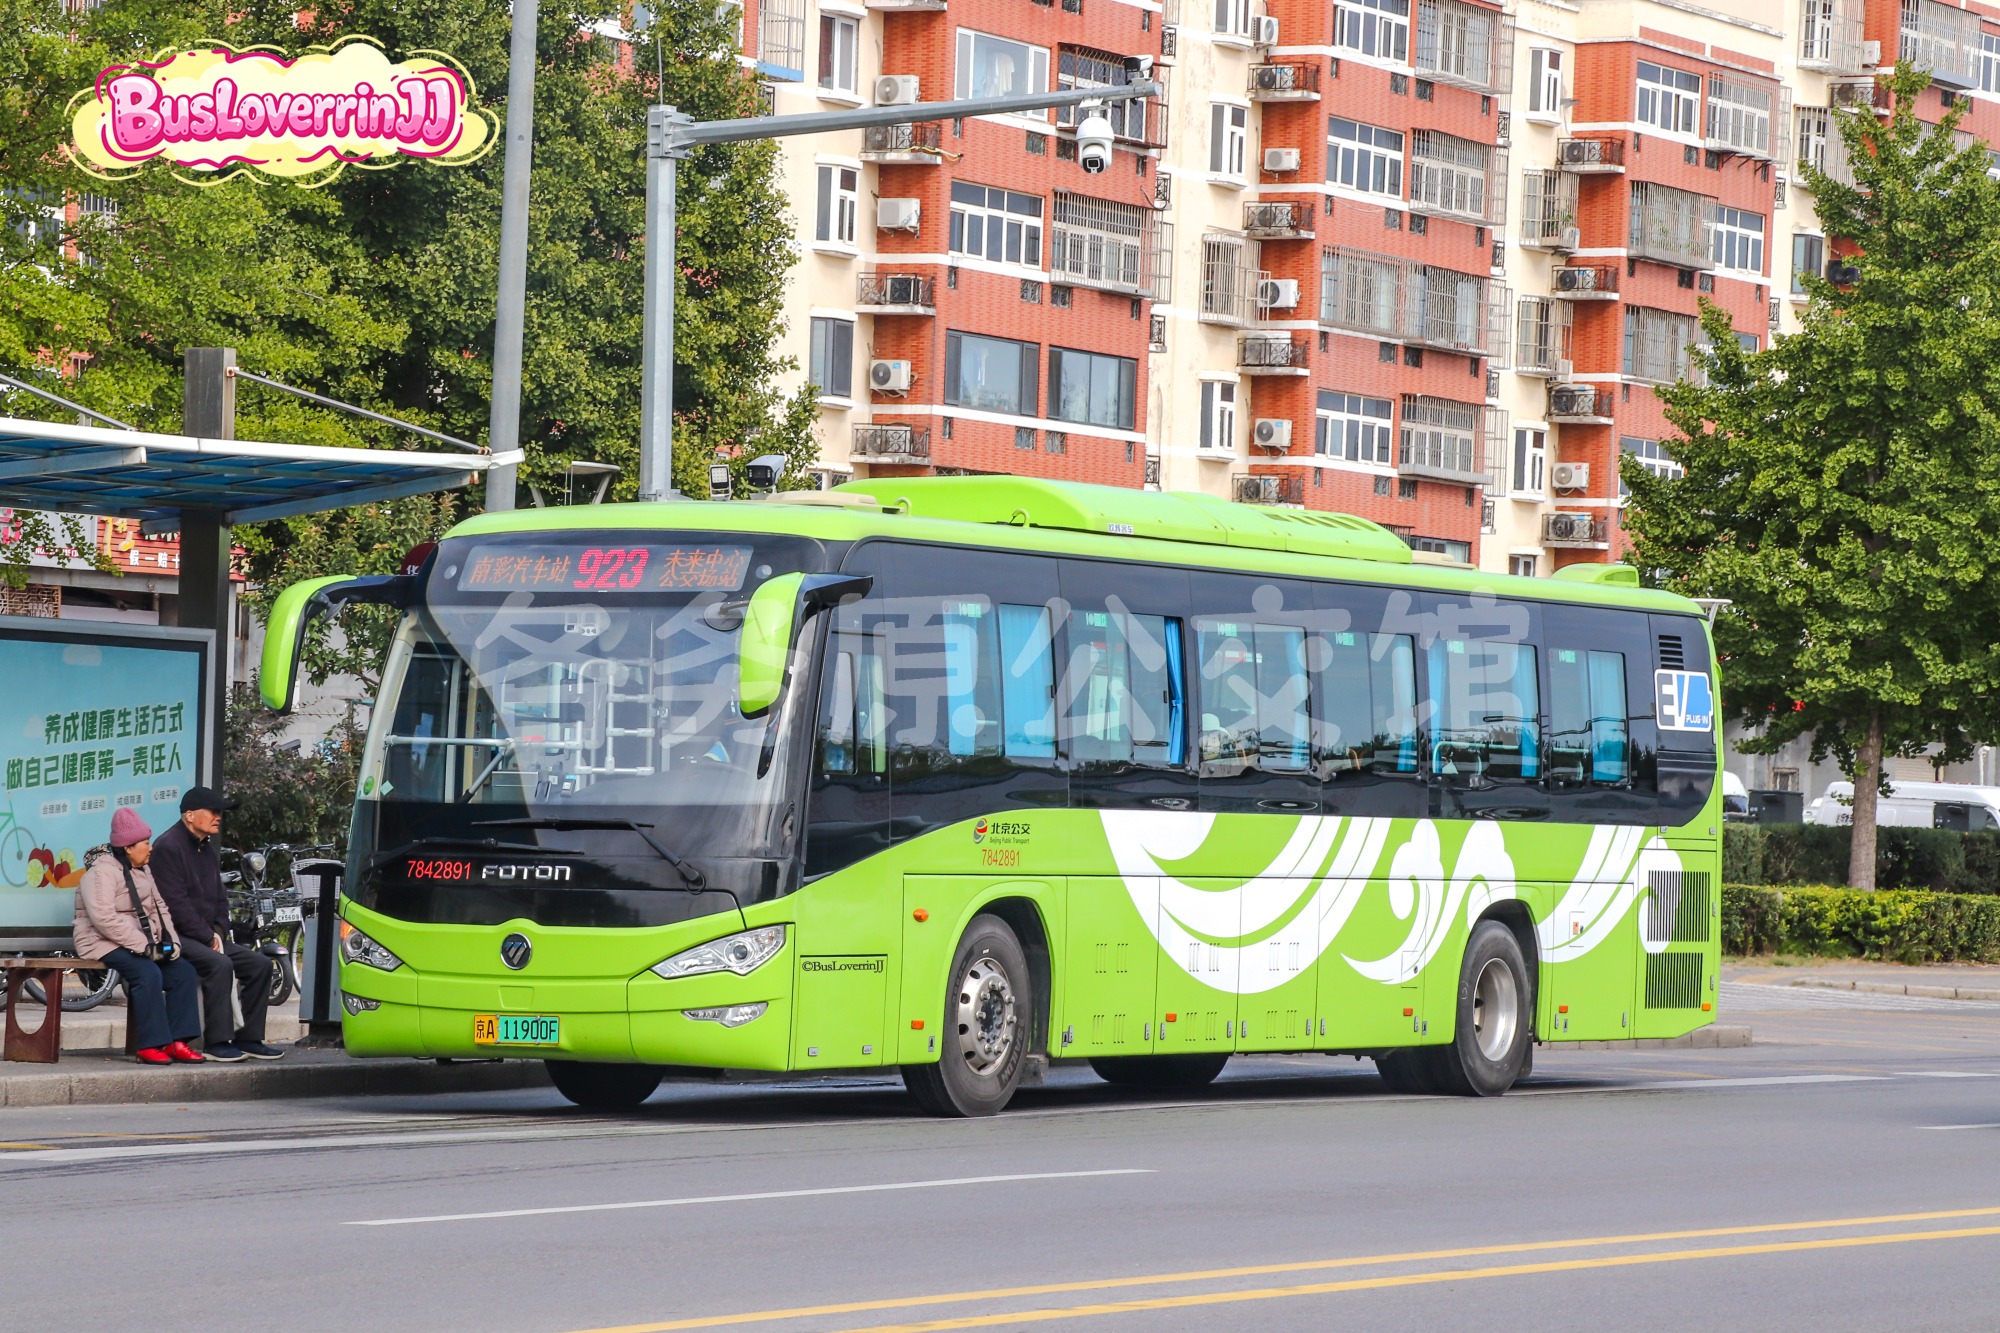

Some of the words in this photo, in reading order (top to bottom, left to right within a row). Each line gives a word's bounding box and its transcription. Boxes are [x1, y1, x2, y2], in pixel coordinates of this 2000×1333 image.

[665, 549, 746, 568] 未来中心
[469, 555, 572, 586] 南彩汽车站
[573, 549, 651, 589] 923
[658, 568, 740, 588] 公交场站
[45, 701, 184, 745] 养成健康生活方式
[6, 742, 182, 790] 做自己健康第一责任人
[990, 823, 1031, 834] 北京公交
[990, 837, 1002, 845] Beijing
[982, 849, 1020, 866] 7842891
[407, 860, 472, 881] 7842891
[482, 864, 571, 881] FOTON
